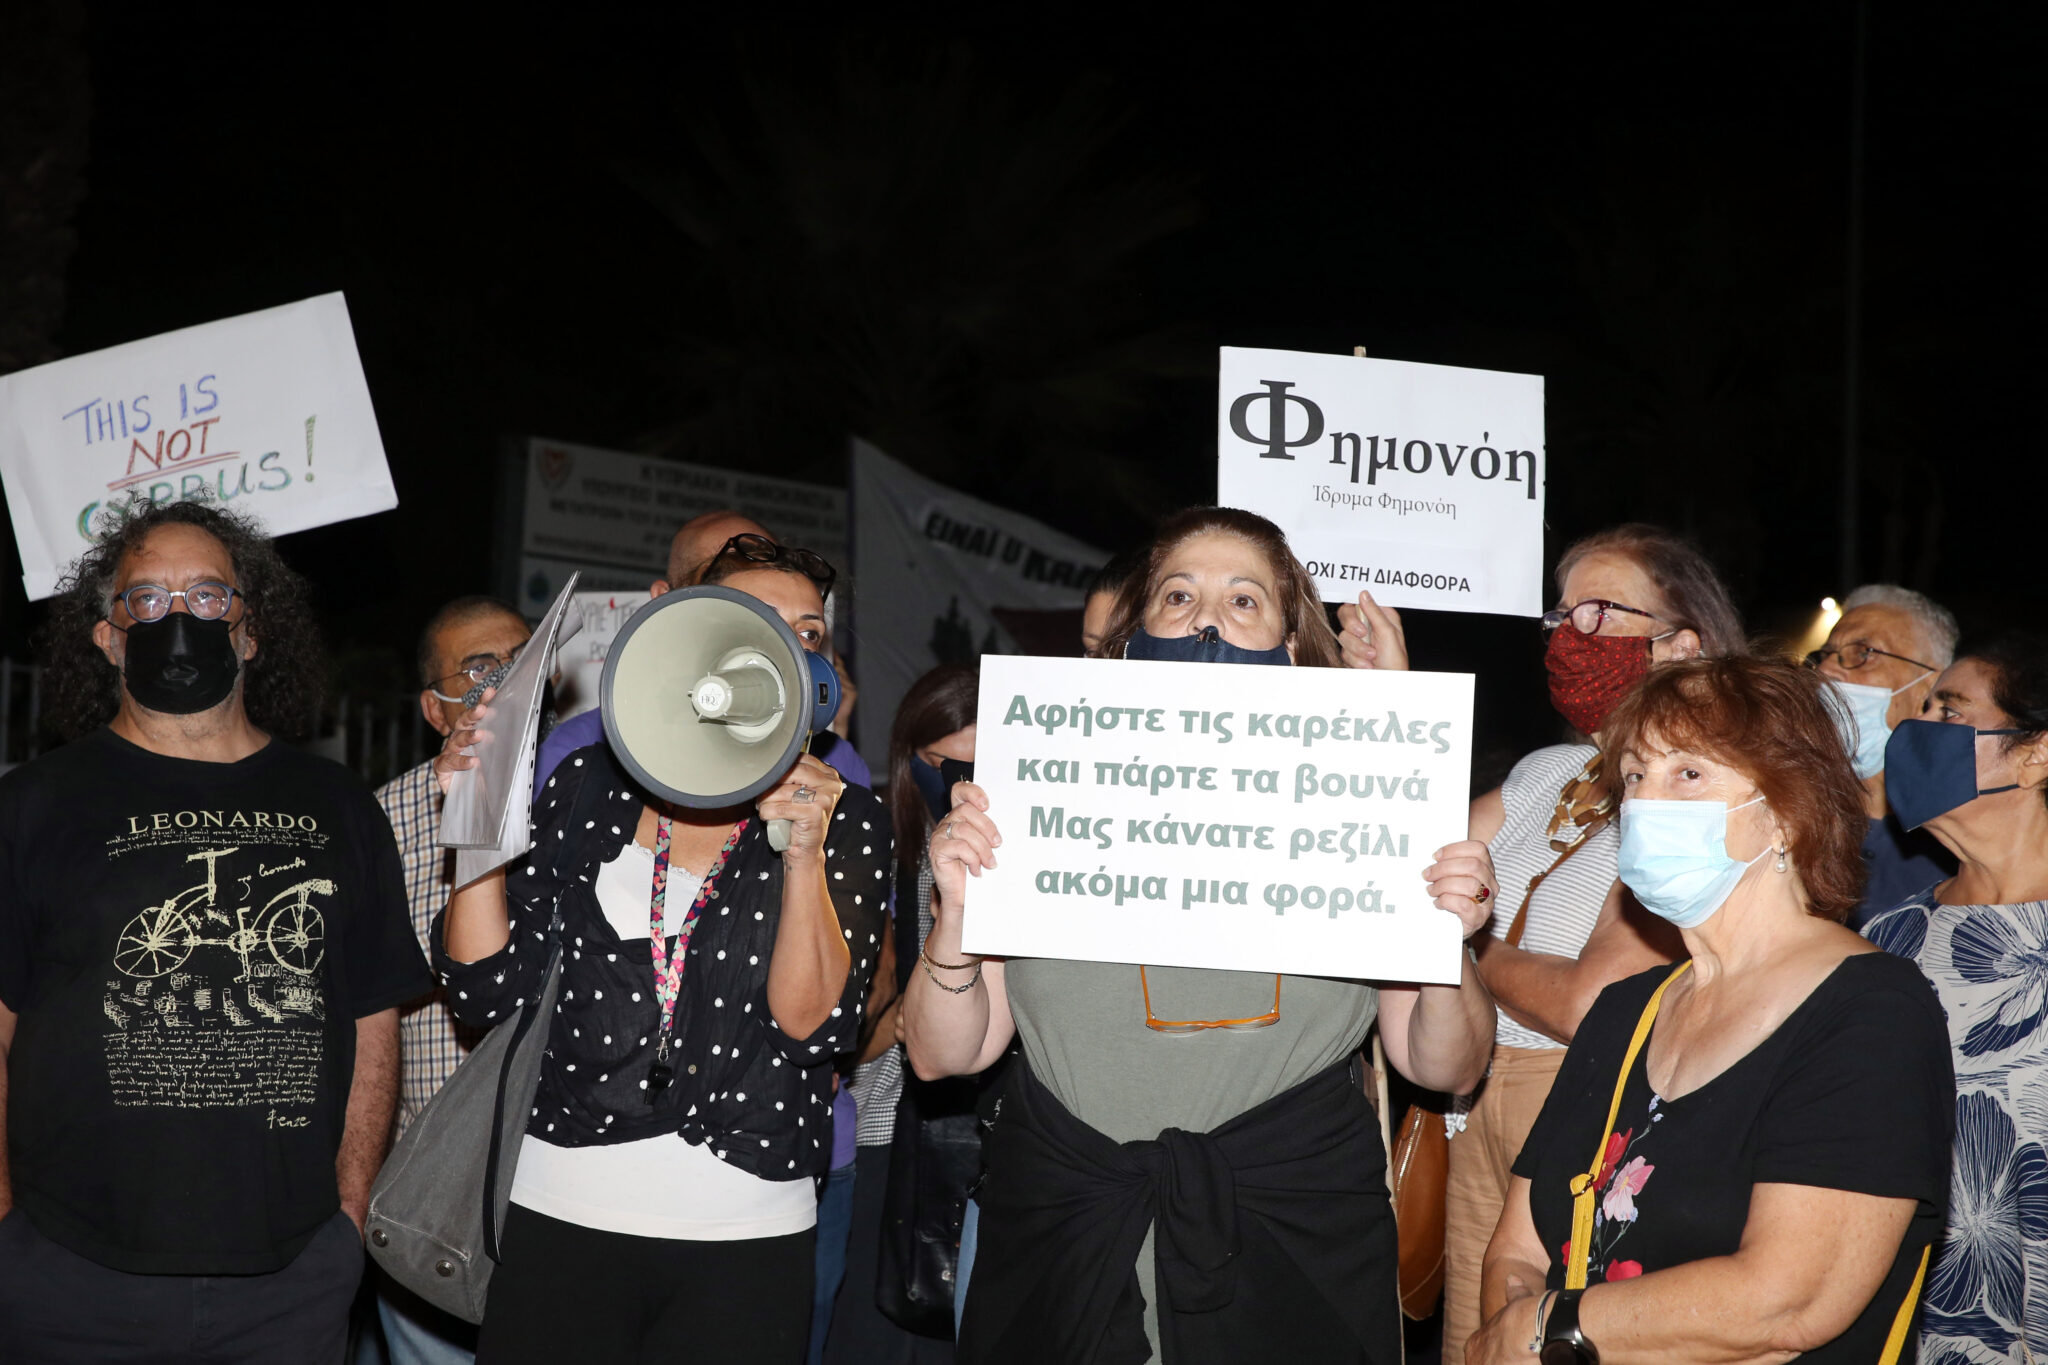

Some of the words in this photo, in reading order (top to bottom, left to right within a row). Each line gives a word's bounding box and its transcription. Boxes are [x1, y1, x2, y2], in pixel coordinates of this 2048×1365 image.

[63, 395, 152, 445] THIS
[180, 375, 219, 420] IS
[126, 416, 221, 475] NOT
[1229, 379, 1537, 500] Φημονόη
[1313, 485, 1373, 510] Ίδρυμα
[1378, 492, 1456, 520] Φημονόη
[1306, 560, 1335, 578] ΟΧΙ
[1339, 564, 1370, 583] ΣΤΗ
[1374, 568, 1471, 593] ΔΙΑΦΘΟΡΑ
[1002, 694, 1166, 738] Αφήστε
[1178, 709, 1235, 744] τις
[1247, 709, 1452, 754] καρέκλες
[1017, 757, 1080, 784] και
[1094, 755, 1219, 796] πάρτε
[1231, 768, 1280, 794] τα
[1294, 762, 1430, 804] βουνά
[127, 810, 318, 835] LEONARDO
[1029, 805, 1113, 850] Μας
[1127, 812, 1275, 851] κάνατε
[1290, 821, 1410, 863] ρεζίλι
[1035, 865, 1168, 906] ακόμα
[1182, 876, 1249, 910] μια
[1263, 880, 1397, 919] φορά.
